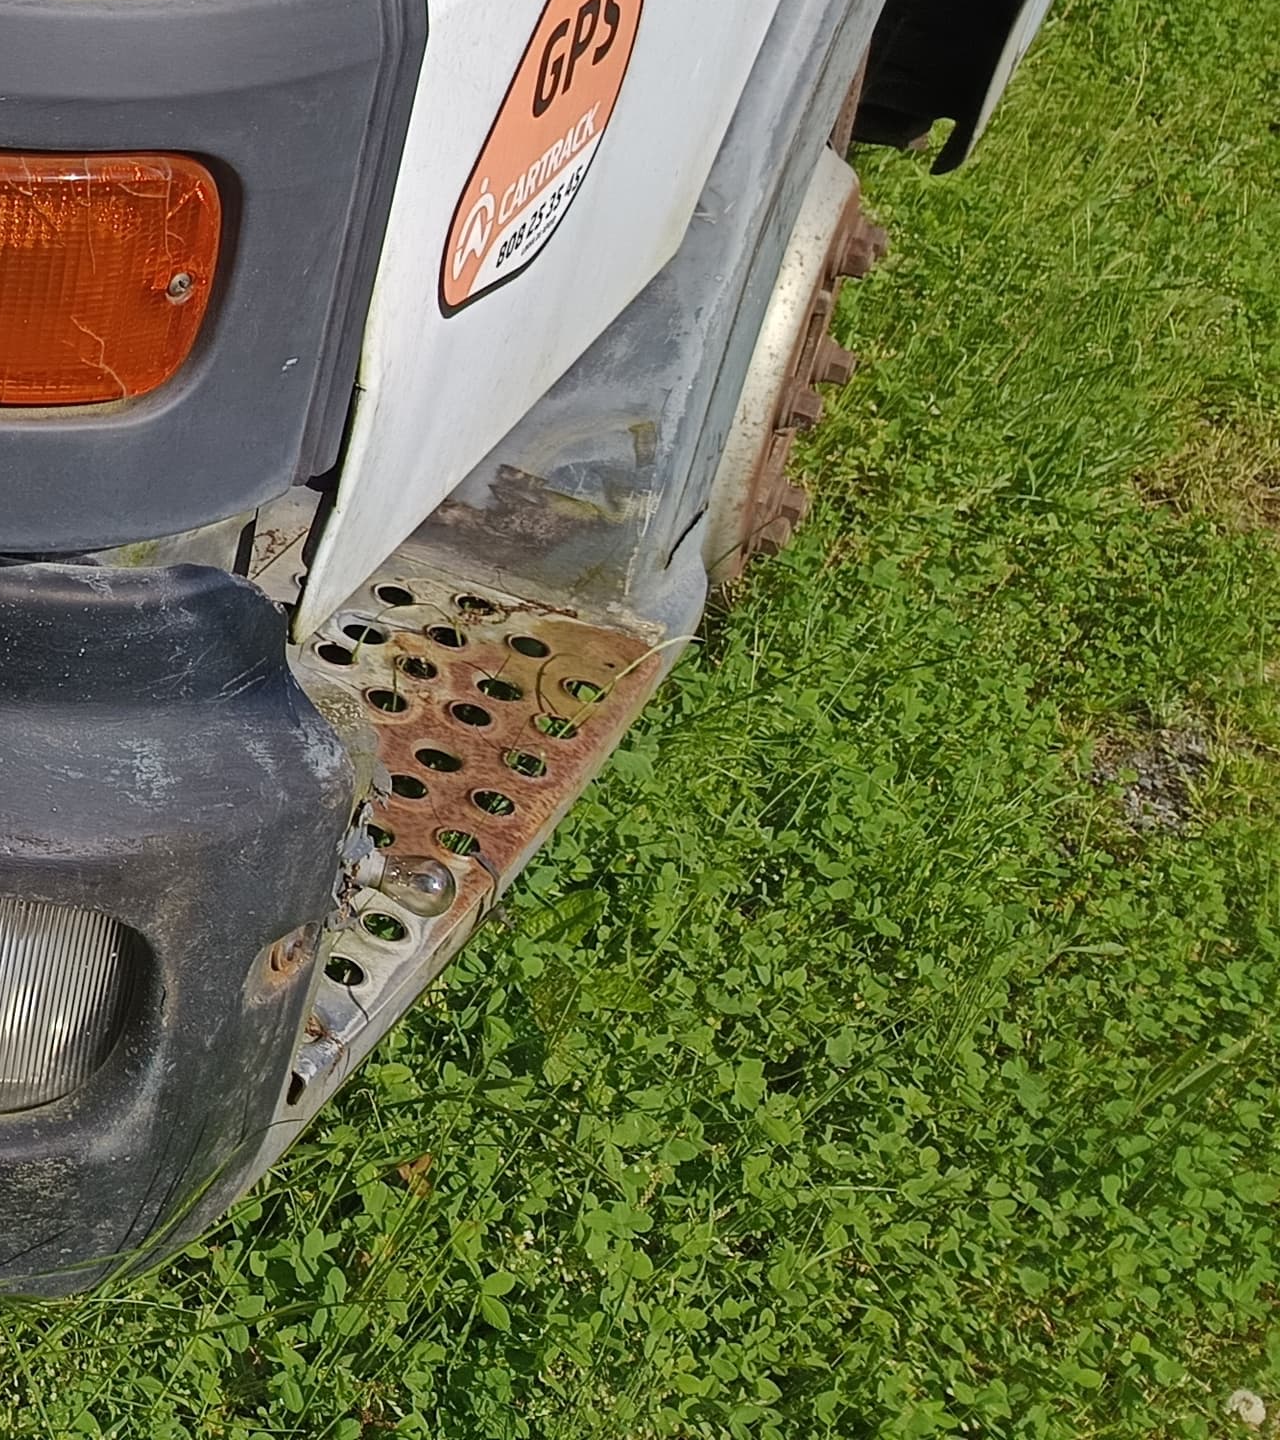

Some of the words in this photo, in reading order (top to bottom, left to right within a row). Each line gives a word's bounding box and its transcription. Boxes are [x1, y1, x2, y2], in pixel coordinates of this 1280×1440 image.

[496, 222, 527, 269] 808
[526, 203, 547, 237] 25
[545, 184, 565, 219] 35
[565, 165, 584, 197] 45
[498, 100, 601, 225] CARTRACK
